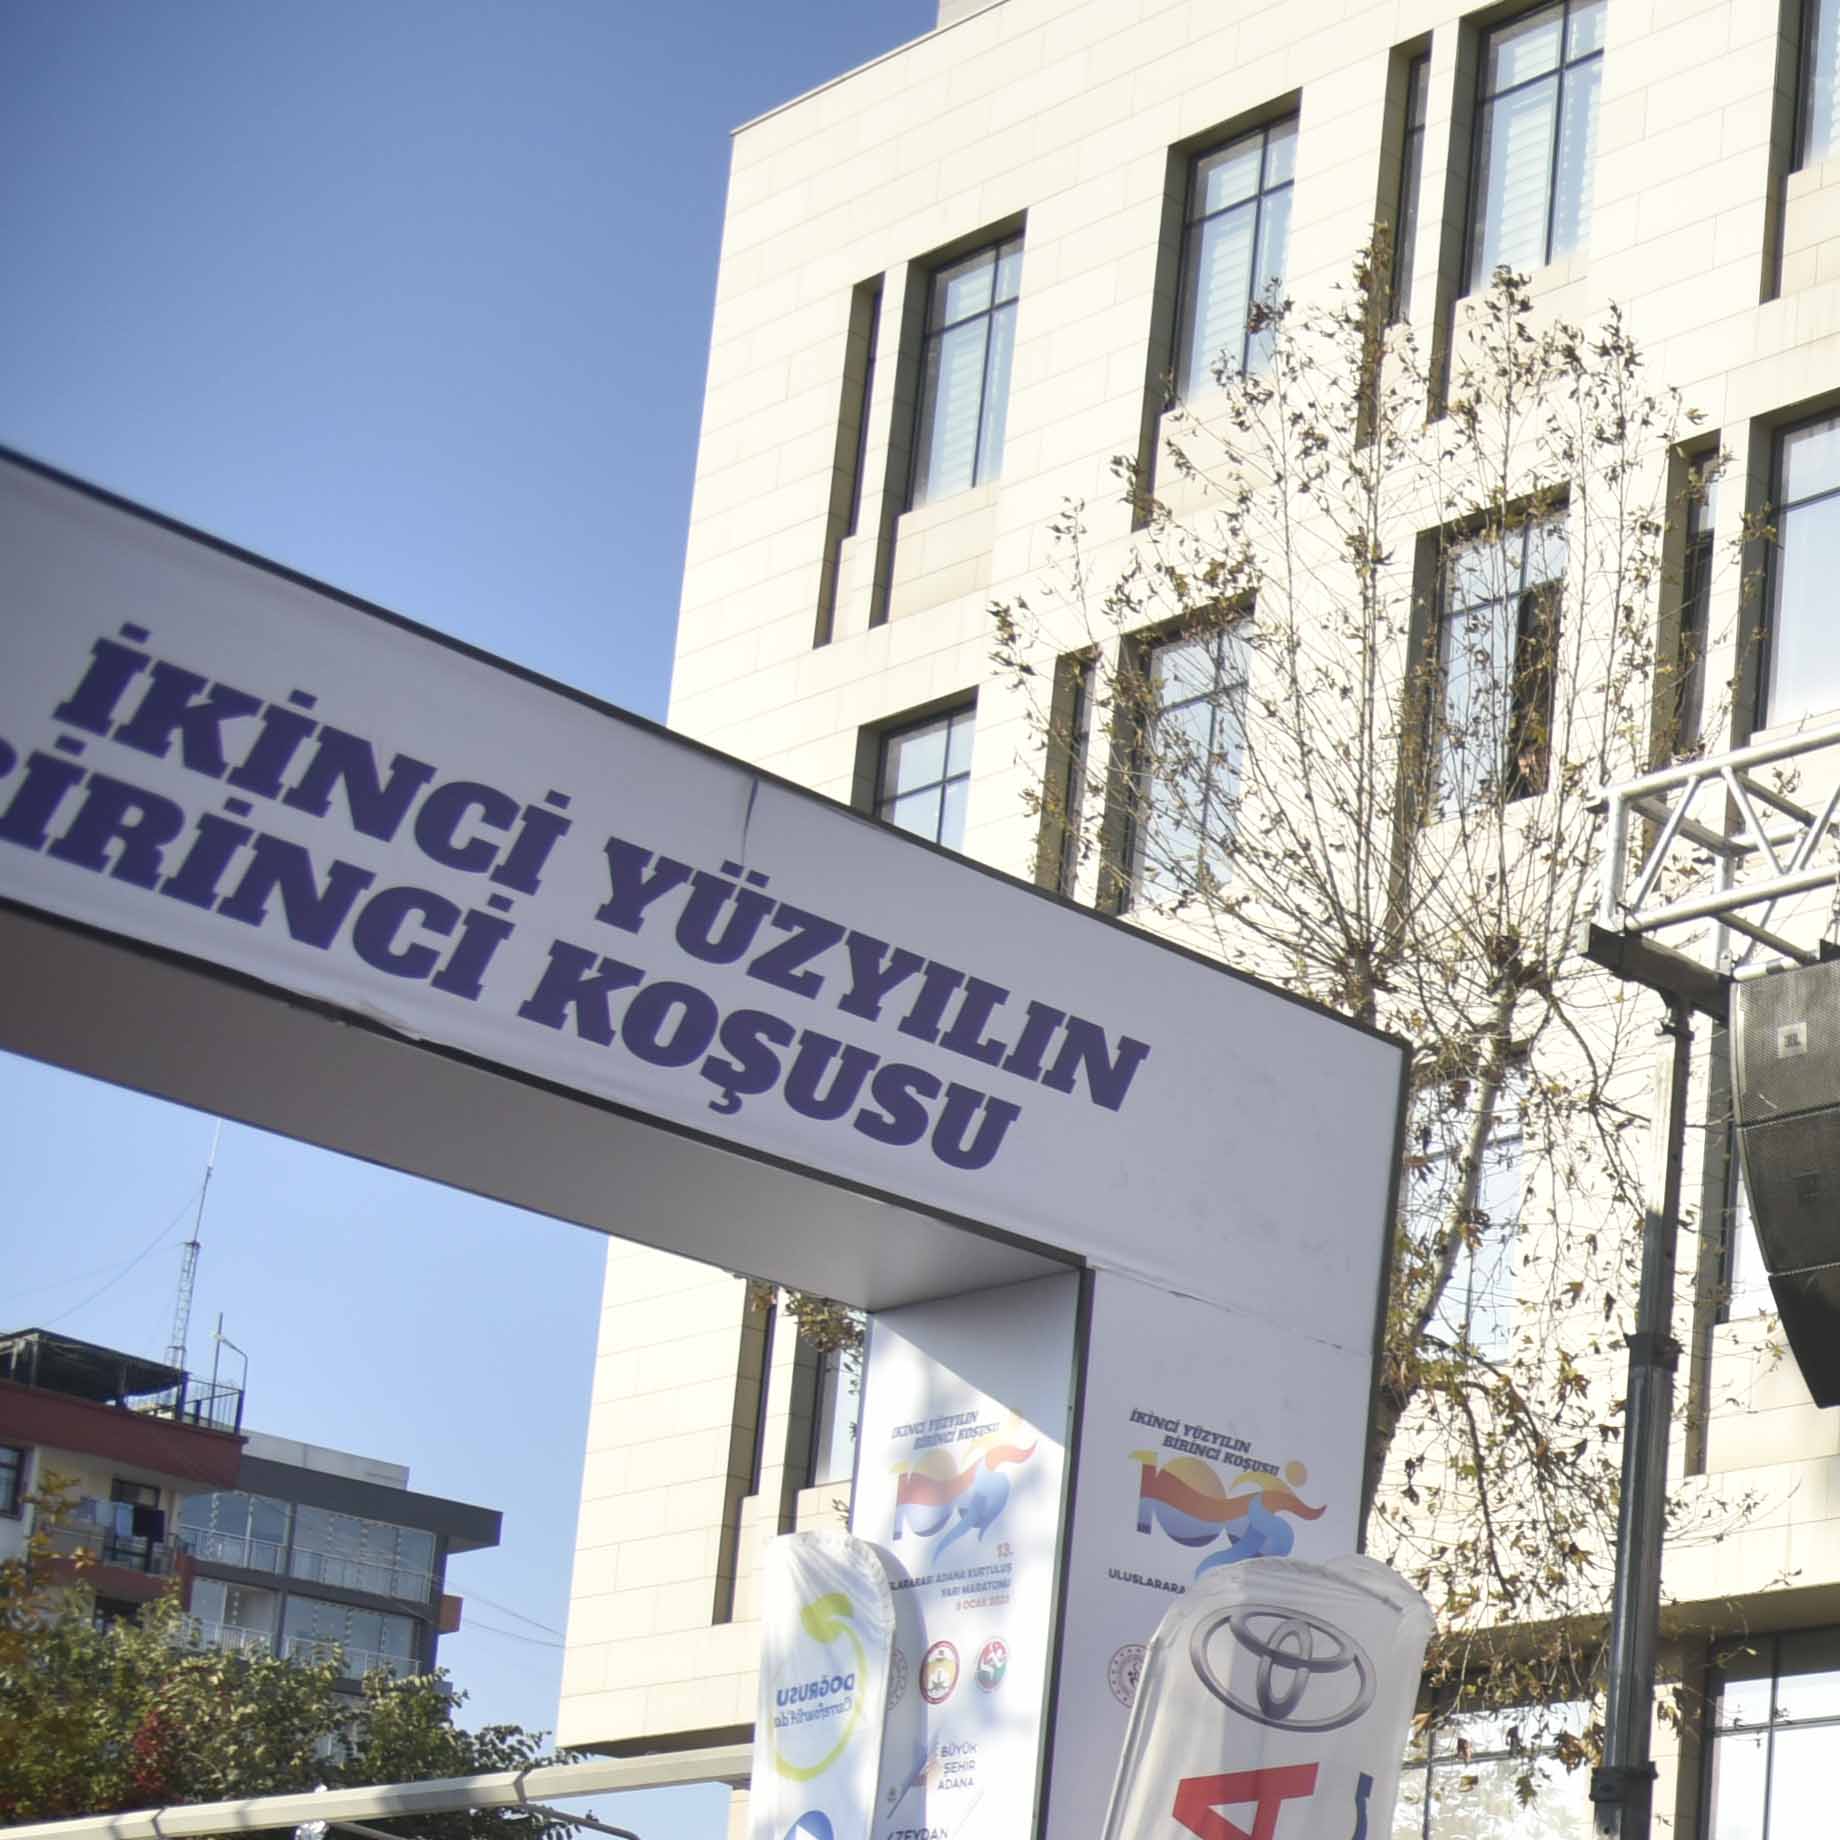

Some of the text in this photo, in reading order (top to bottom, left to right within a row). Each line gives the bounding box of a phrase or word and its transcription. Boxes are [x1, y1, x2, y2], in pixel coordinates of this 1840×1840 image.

[0, 735, 1022, 1175] İRİNCİ KOŞUSU
[52, 621, 1151, 1112] İKİNCİ YÜZYILIN
[1129, 1408, 1252, 1453] İKİNCİ YÜZYILIN
[1162, 1435, 1280, 1477] BİRİNCİ KOŞUSU
